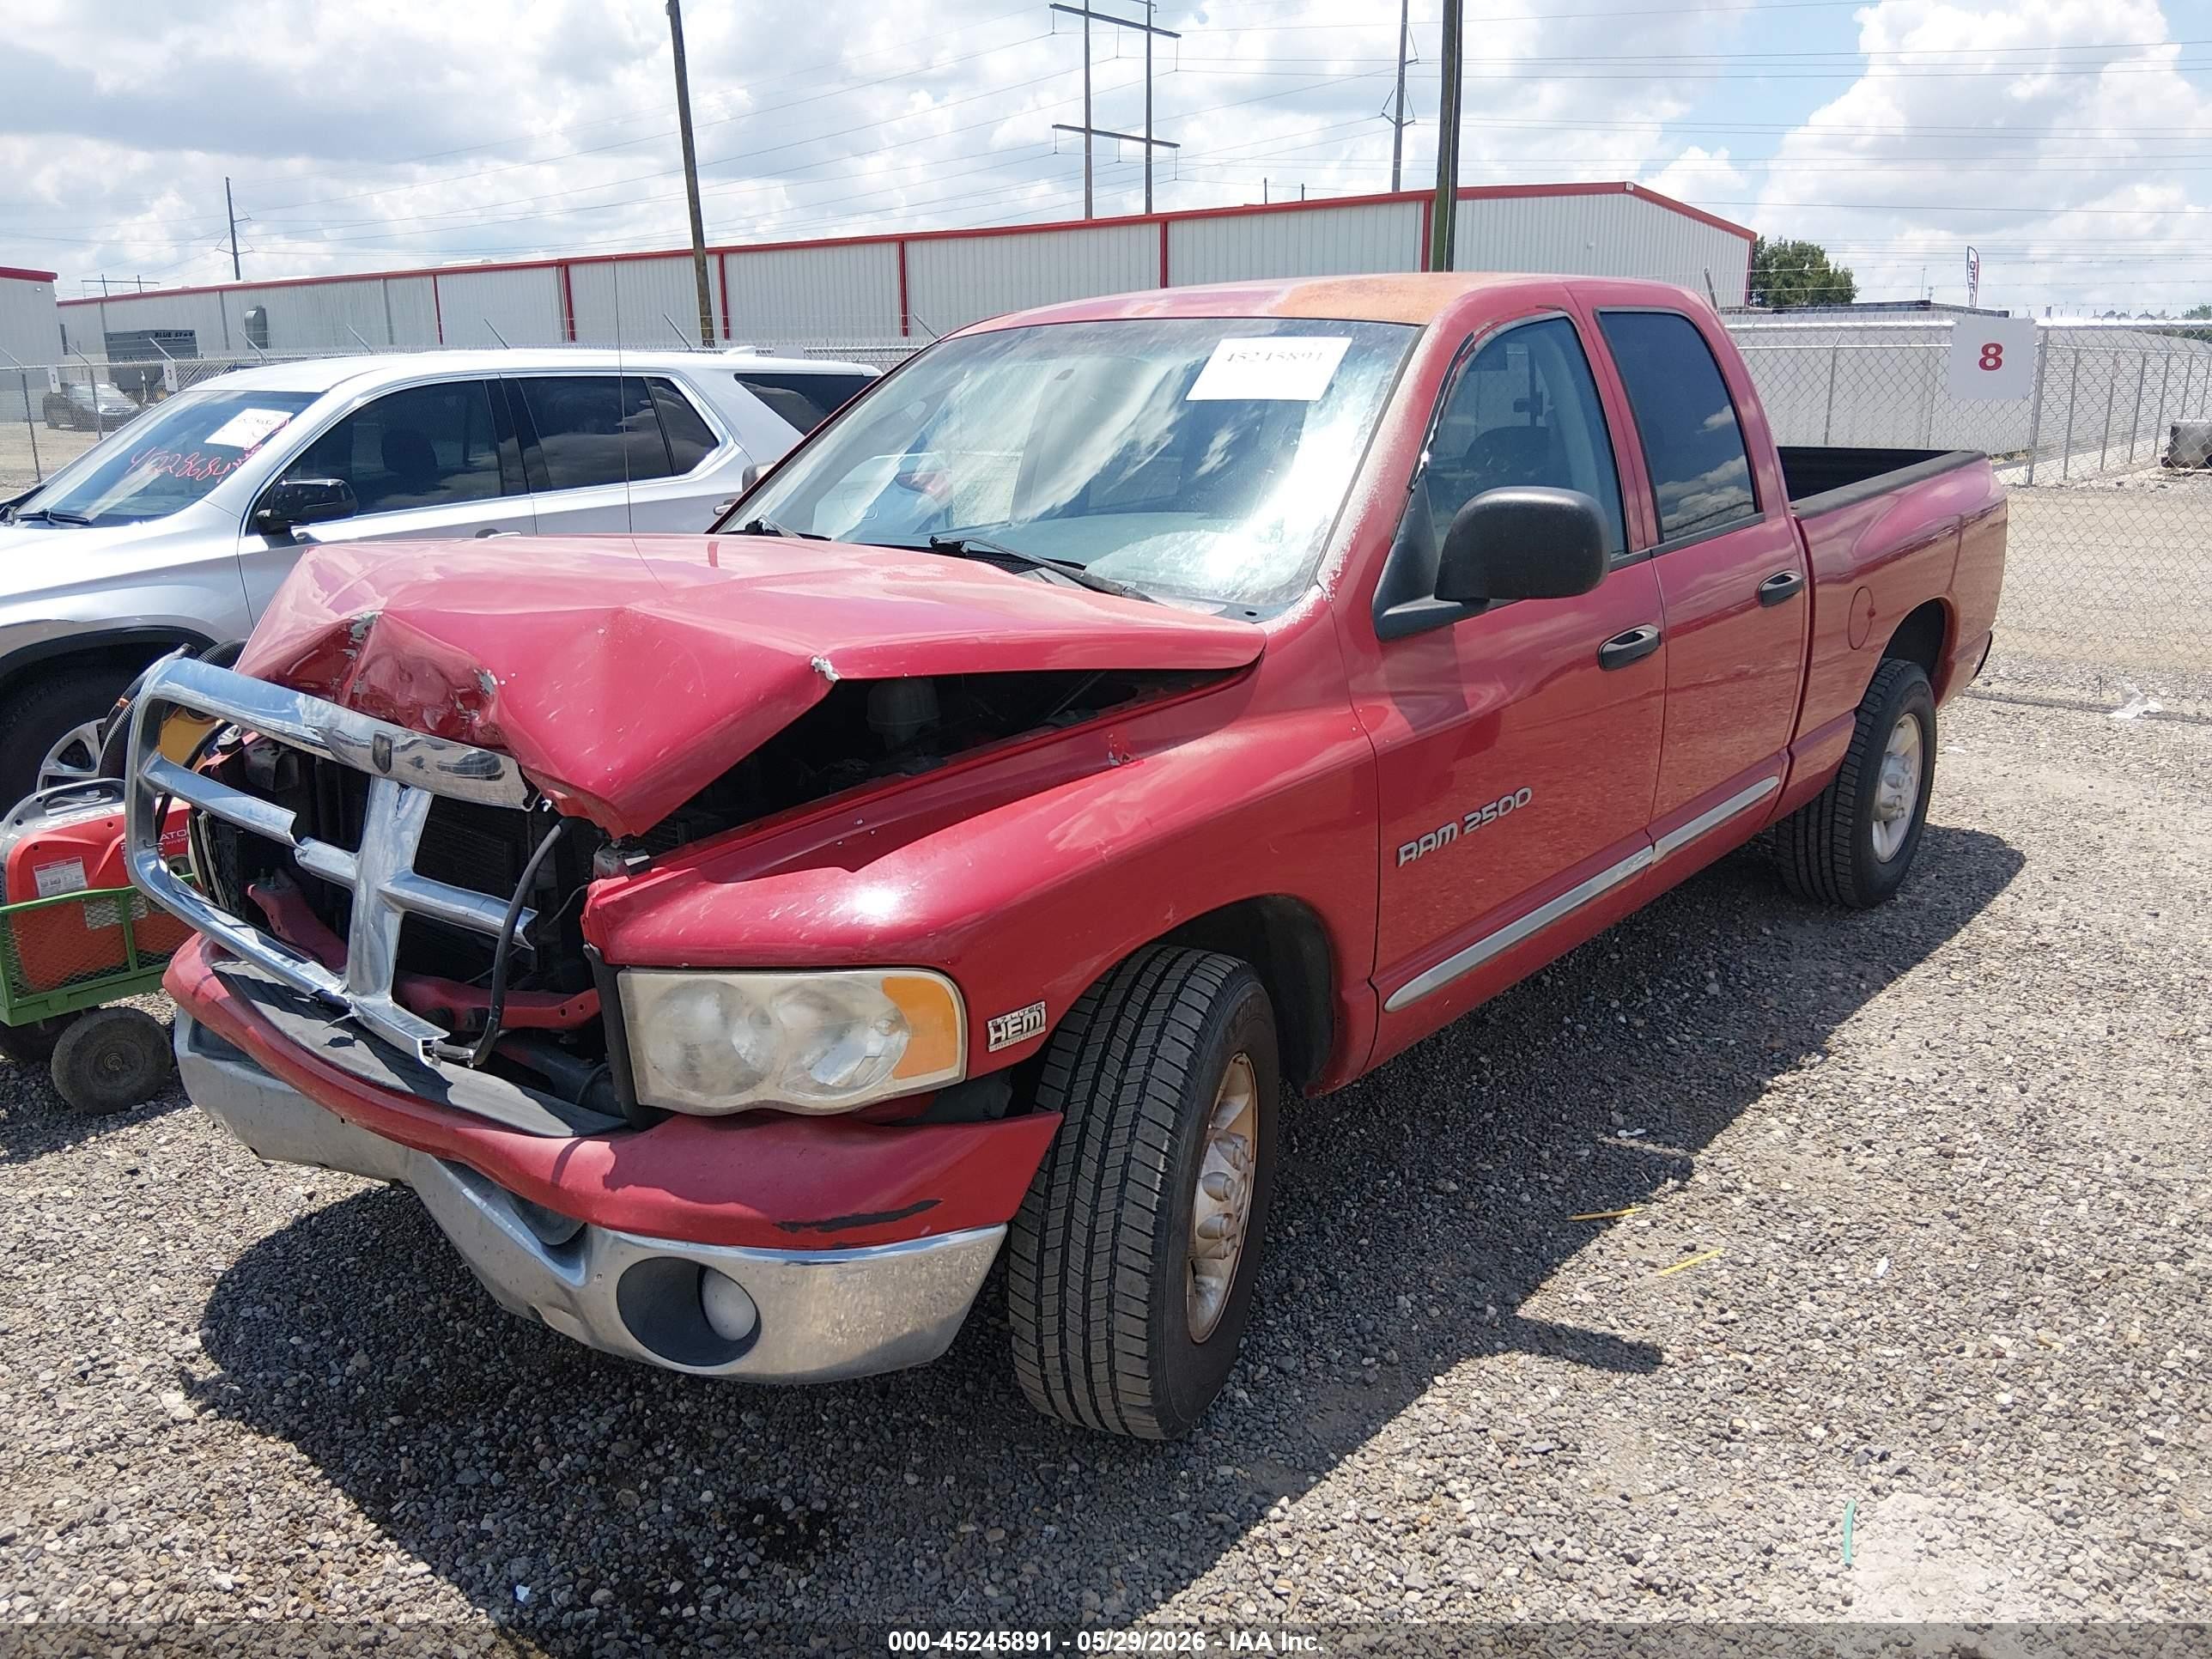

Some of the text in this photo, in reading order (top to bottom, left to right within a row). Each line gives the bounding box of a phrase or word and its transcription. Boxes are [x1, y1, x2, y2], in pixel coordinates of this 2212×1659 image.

[1978, 343, 2003, 371] 8
[167, 369, 173, 380] 3
[1396, 786, 1533, 867] RAM 2500
[1011, 1004, 1043, 1020] LITER
[988, 1007, 1046, 1046] HEMI
